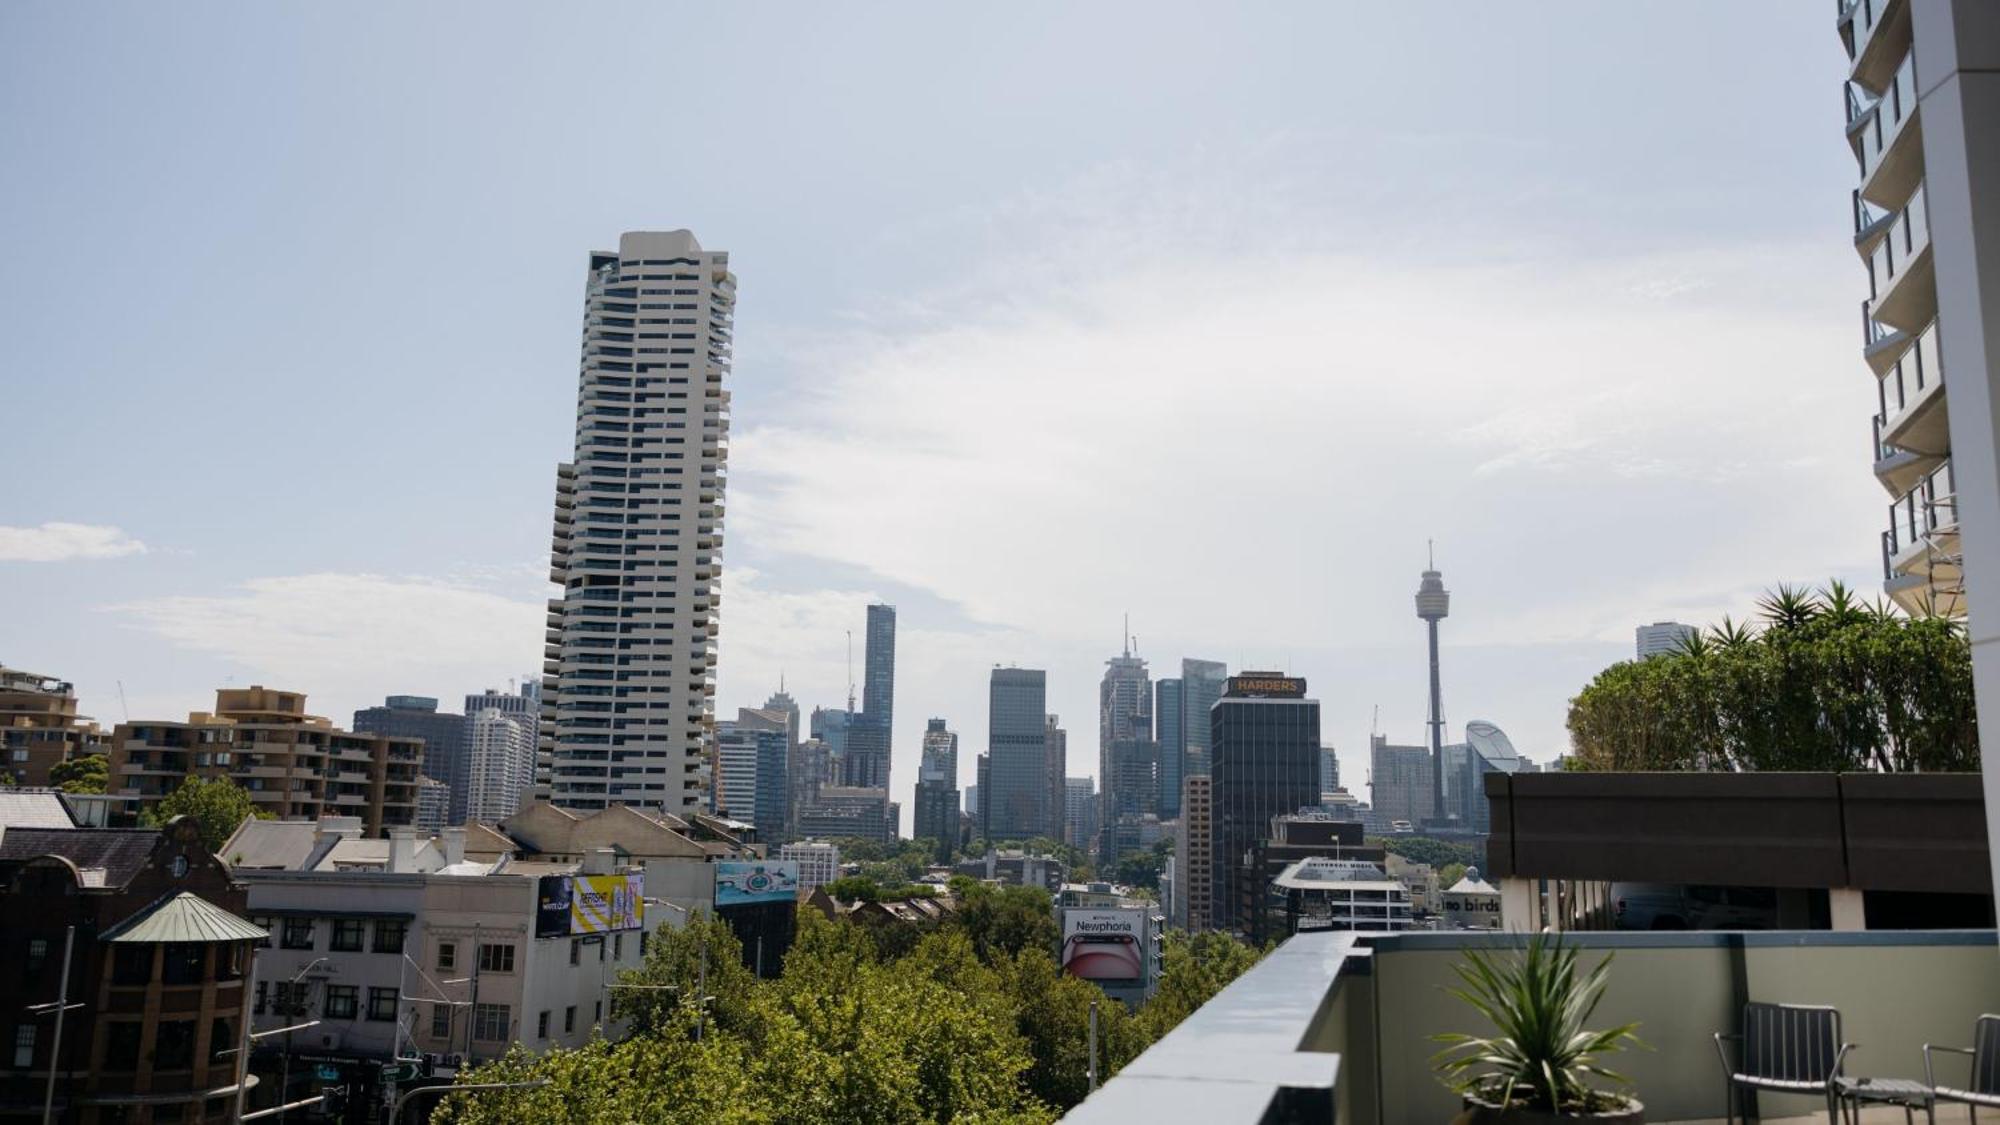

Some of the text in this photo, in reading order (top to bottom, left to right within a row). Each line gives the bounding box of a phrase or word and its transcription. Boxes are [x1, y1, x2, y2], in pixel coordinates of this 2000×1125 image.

[1237, 680, 1298, 692] HARDERS
[1464, 896, 1500, 912] birds
[1076, 921, 1132, 932] Newphoria
